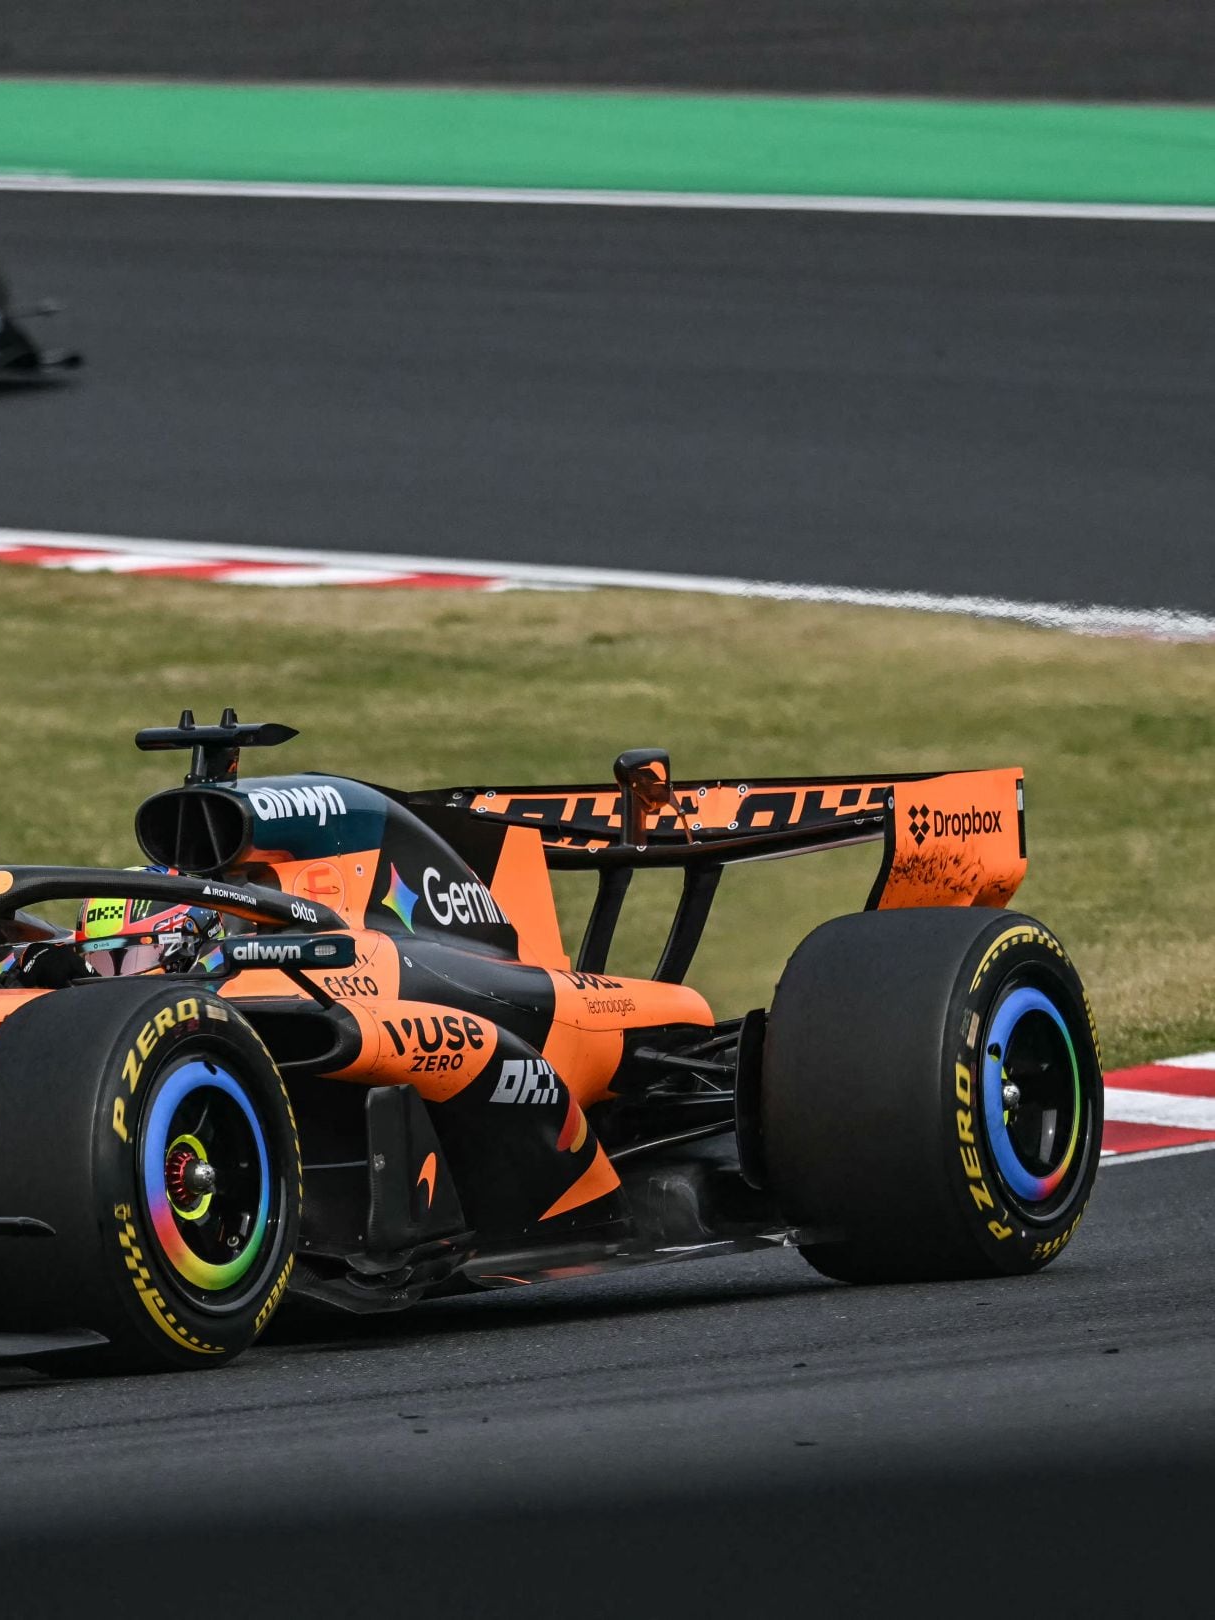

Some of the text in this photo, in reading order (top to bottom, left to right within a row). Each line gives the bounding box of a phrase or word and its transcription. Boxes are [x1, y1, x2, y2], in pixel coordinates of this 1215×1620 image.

[248, 784, 346, 826] allwyn
[932, 807, 1003, 841] Dropbox
[212, 888, 257, 906] IRON MOUNTAIN
[86, 906, 124, 923] OKX
[291, 901, 318, 925] okta
[233, 942, 301, 965] allwyn
[582, 995, 636, 1017] Technologies
[113, 1096, 128, 1143] P
[122, 997, 199, 1094] ZERO
[410, 1053, 464, 1073] ZERO
[955, 1061, 995, 1212] ZERO
[988, 1220, 1014, 1241] P
